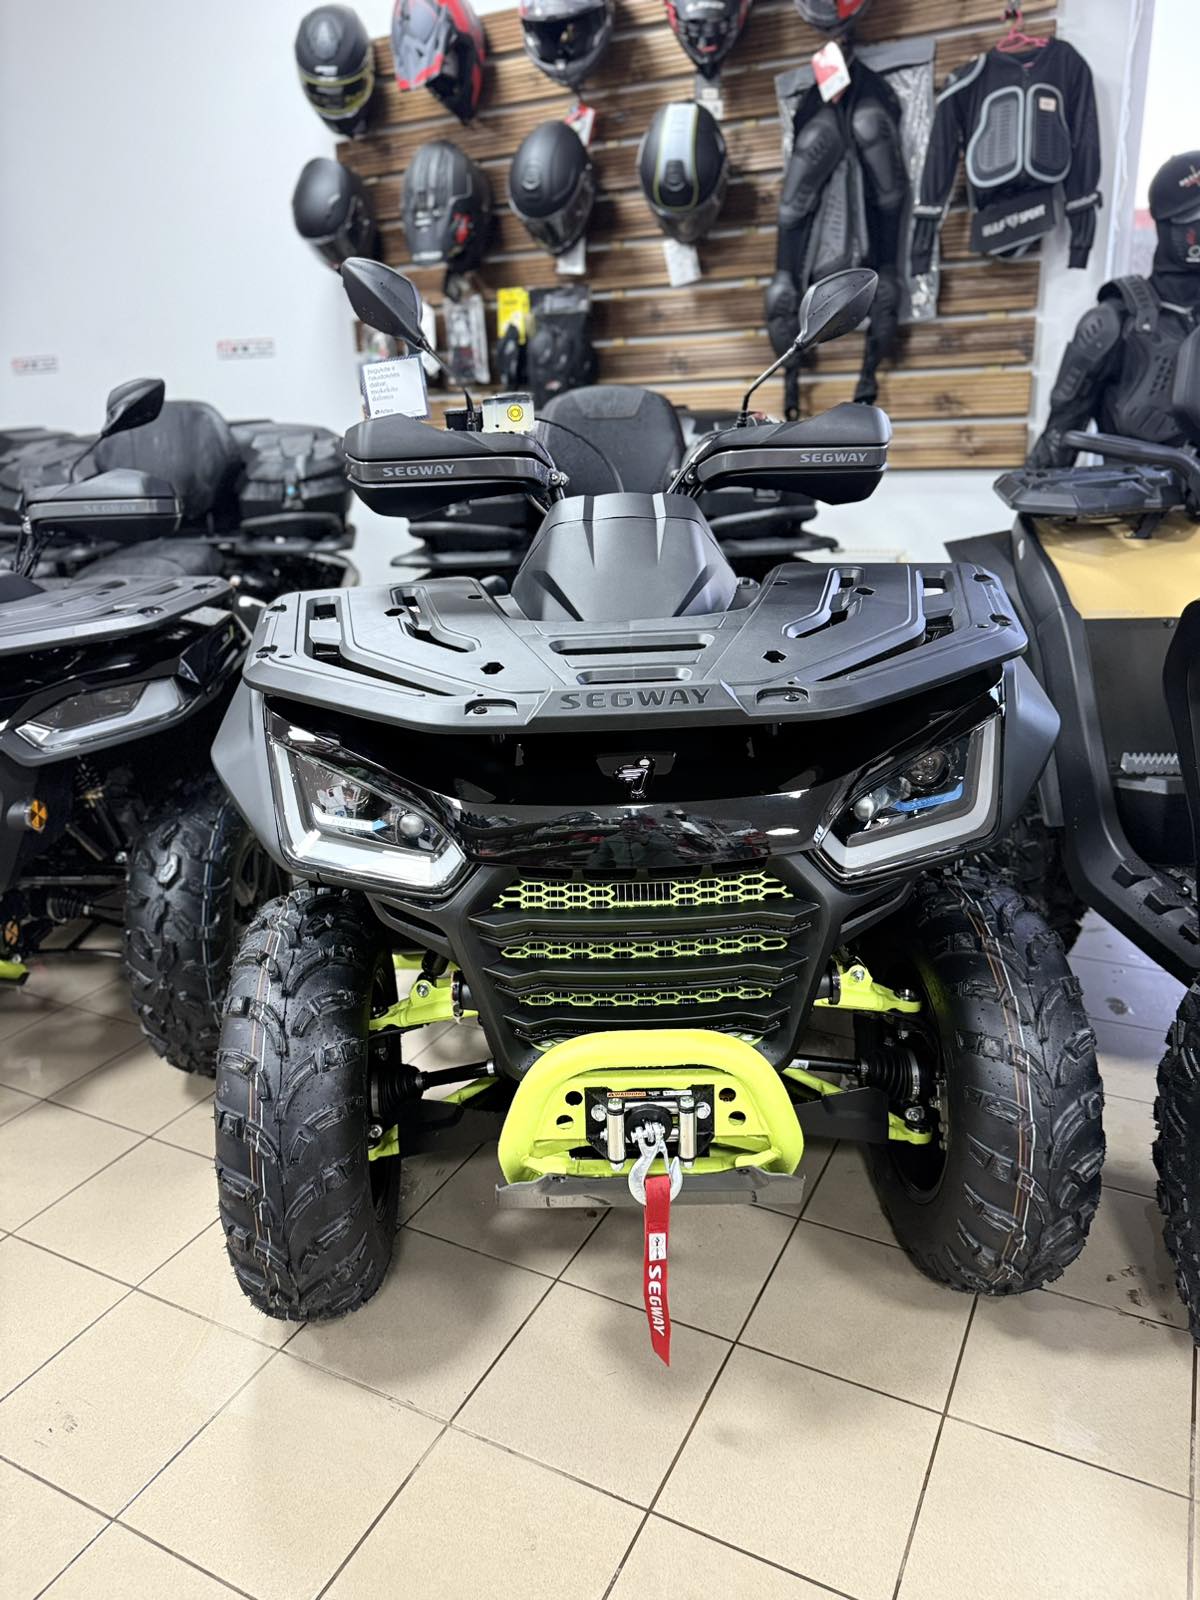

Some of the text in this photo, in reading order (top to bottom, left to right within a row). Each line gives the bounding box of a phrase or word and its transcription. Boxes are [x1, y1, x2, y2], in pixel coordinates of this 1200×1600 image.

[799, 452, 868, 463] SEGWAY
[382, 464, 455, 477] SEGWAY
[559, 687, 711, 710] SEGWAY
[648, 1265, 665, 1336] SEGWAY
